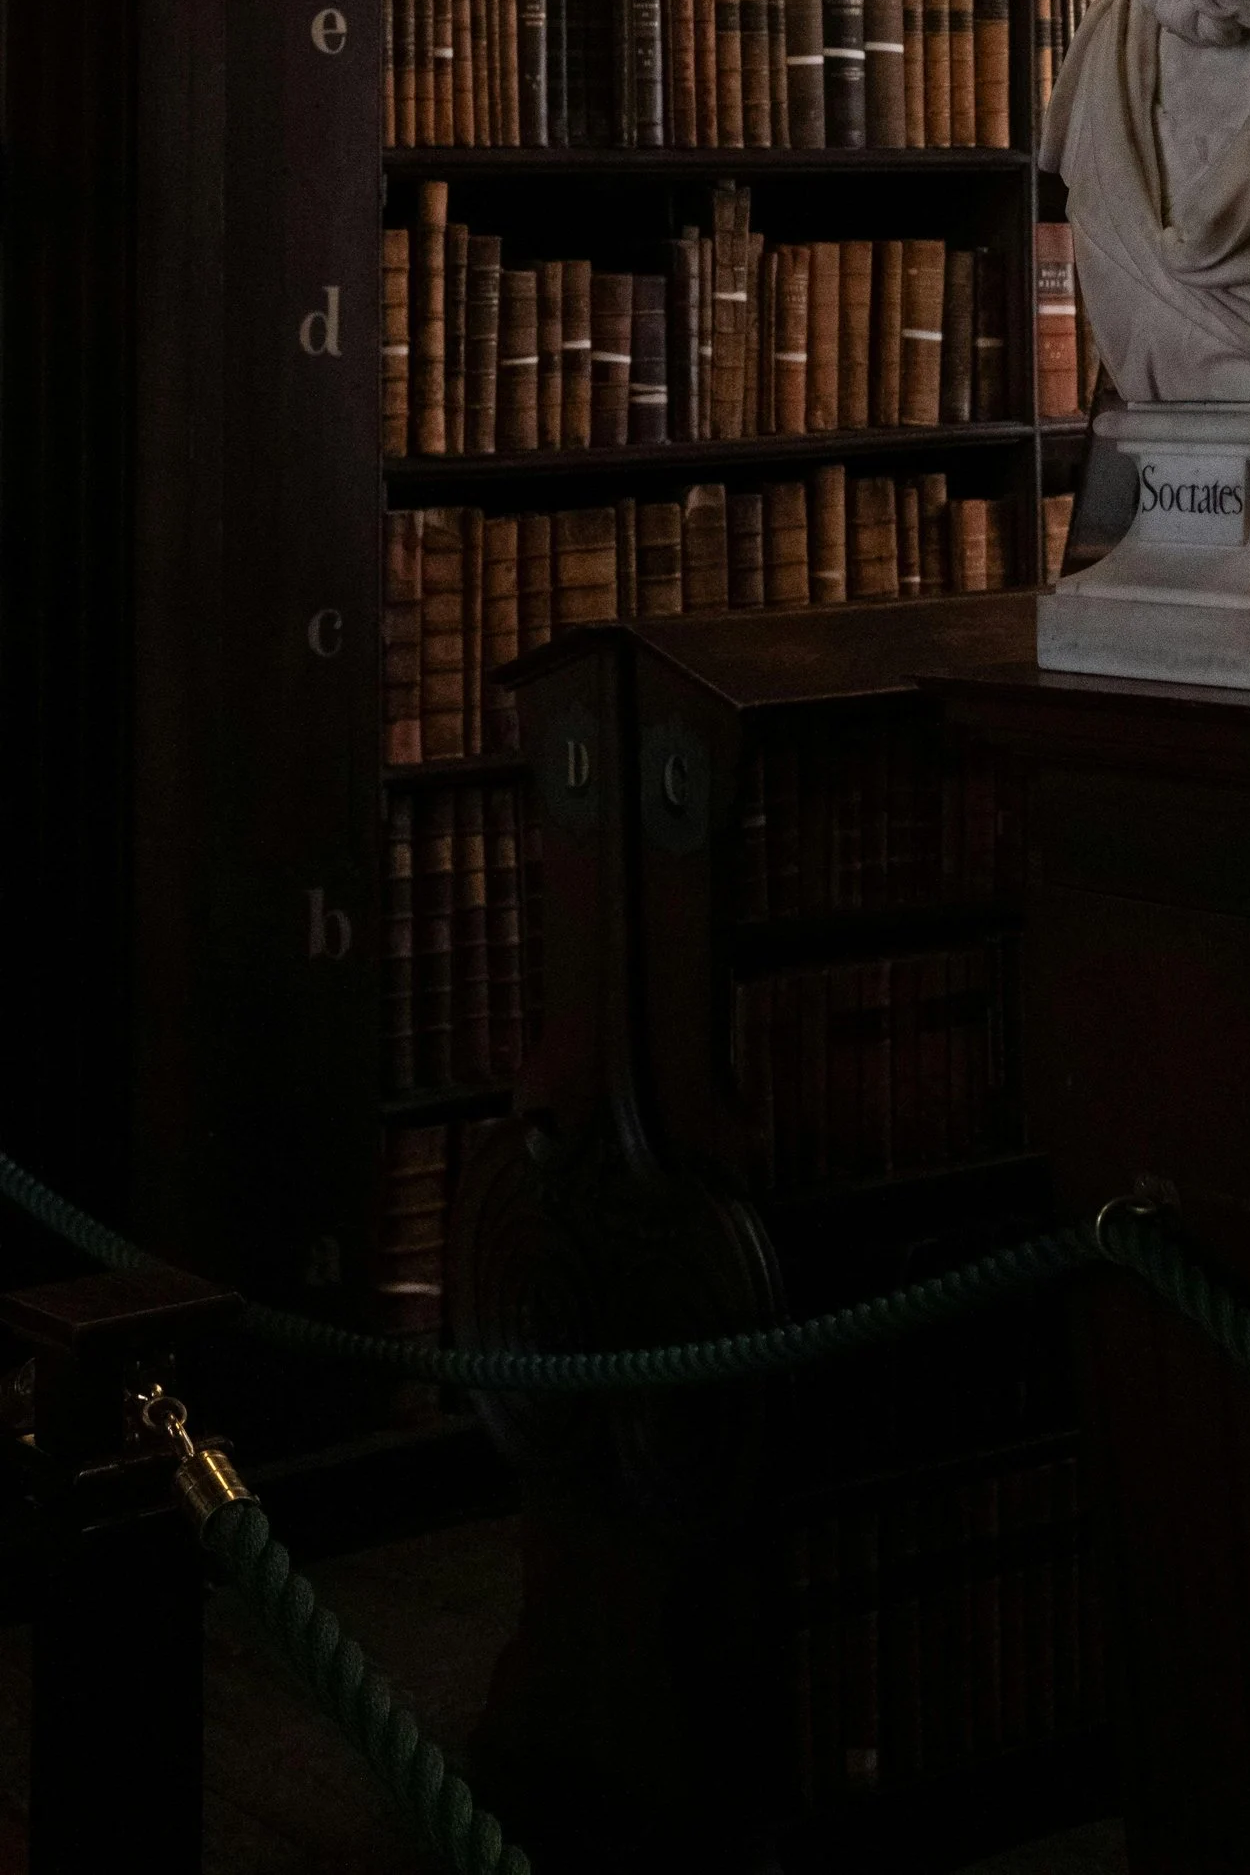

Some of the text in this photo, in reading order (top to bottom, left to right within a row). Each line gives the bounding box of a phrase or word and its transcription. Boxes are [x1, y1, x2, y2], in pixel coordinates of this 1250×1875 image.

[311, 8, 347, 54] e
[299, 284, 341, 357] d
[1141, 465, 1244, 515] Socrates
[306, 609, 343, 658] c
[566, 739, 591, 789] D
[663, 754, 688, 807] C
[308, 887, 353, 960] b
